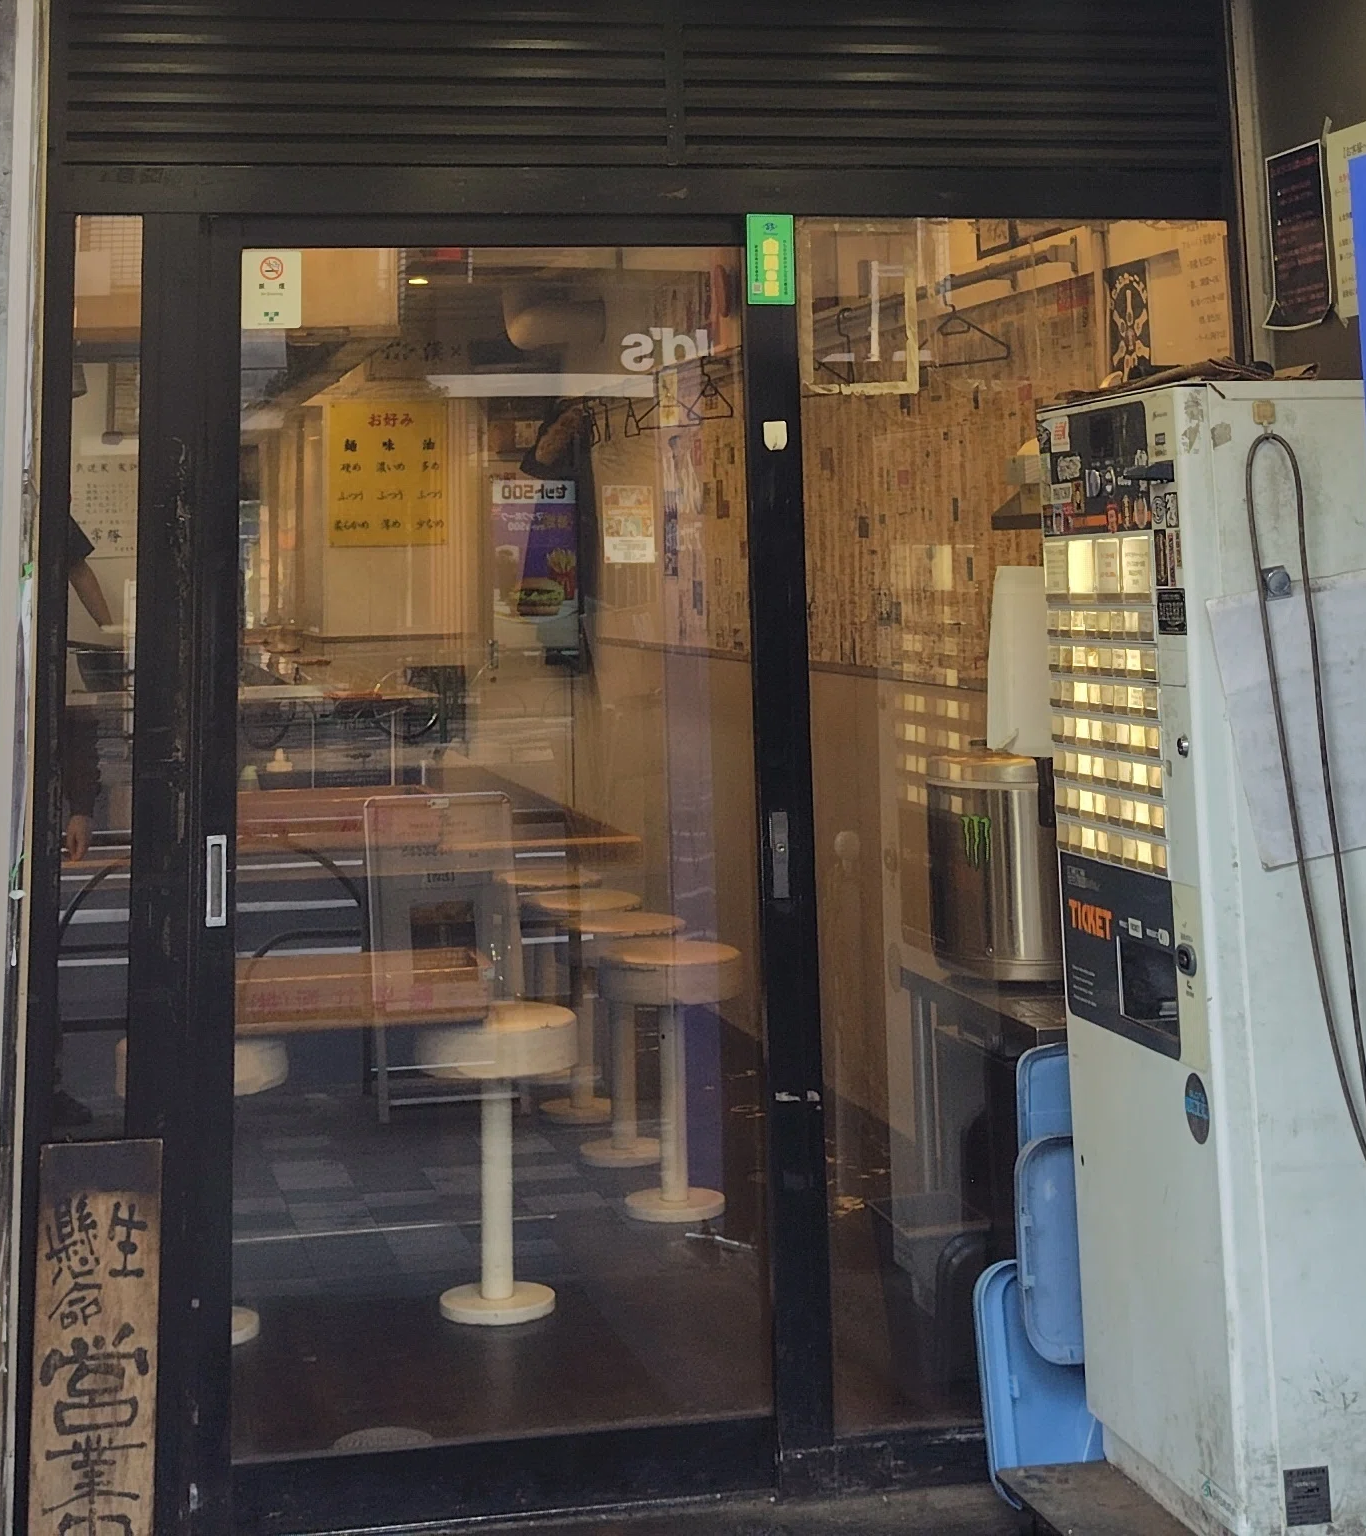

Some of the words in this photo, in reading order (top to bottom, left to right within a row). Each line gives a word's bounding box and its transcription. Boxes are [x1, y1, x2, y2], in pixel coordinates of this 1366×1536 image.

[367, 412, 415, 428] お好み
[382, 437, 396, 452] 味
[422, 437, 436, 452] 油
[1068, 898, 1112, 941] TICKET
